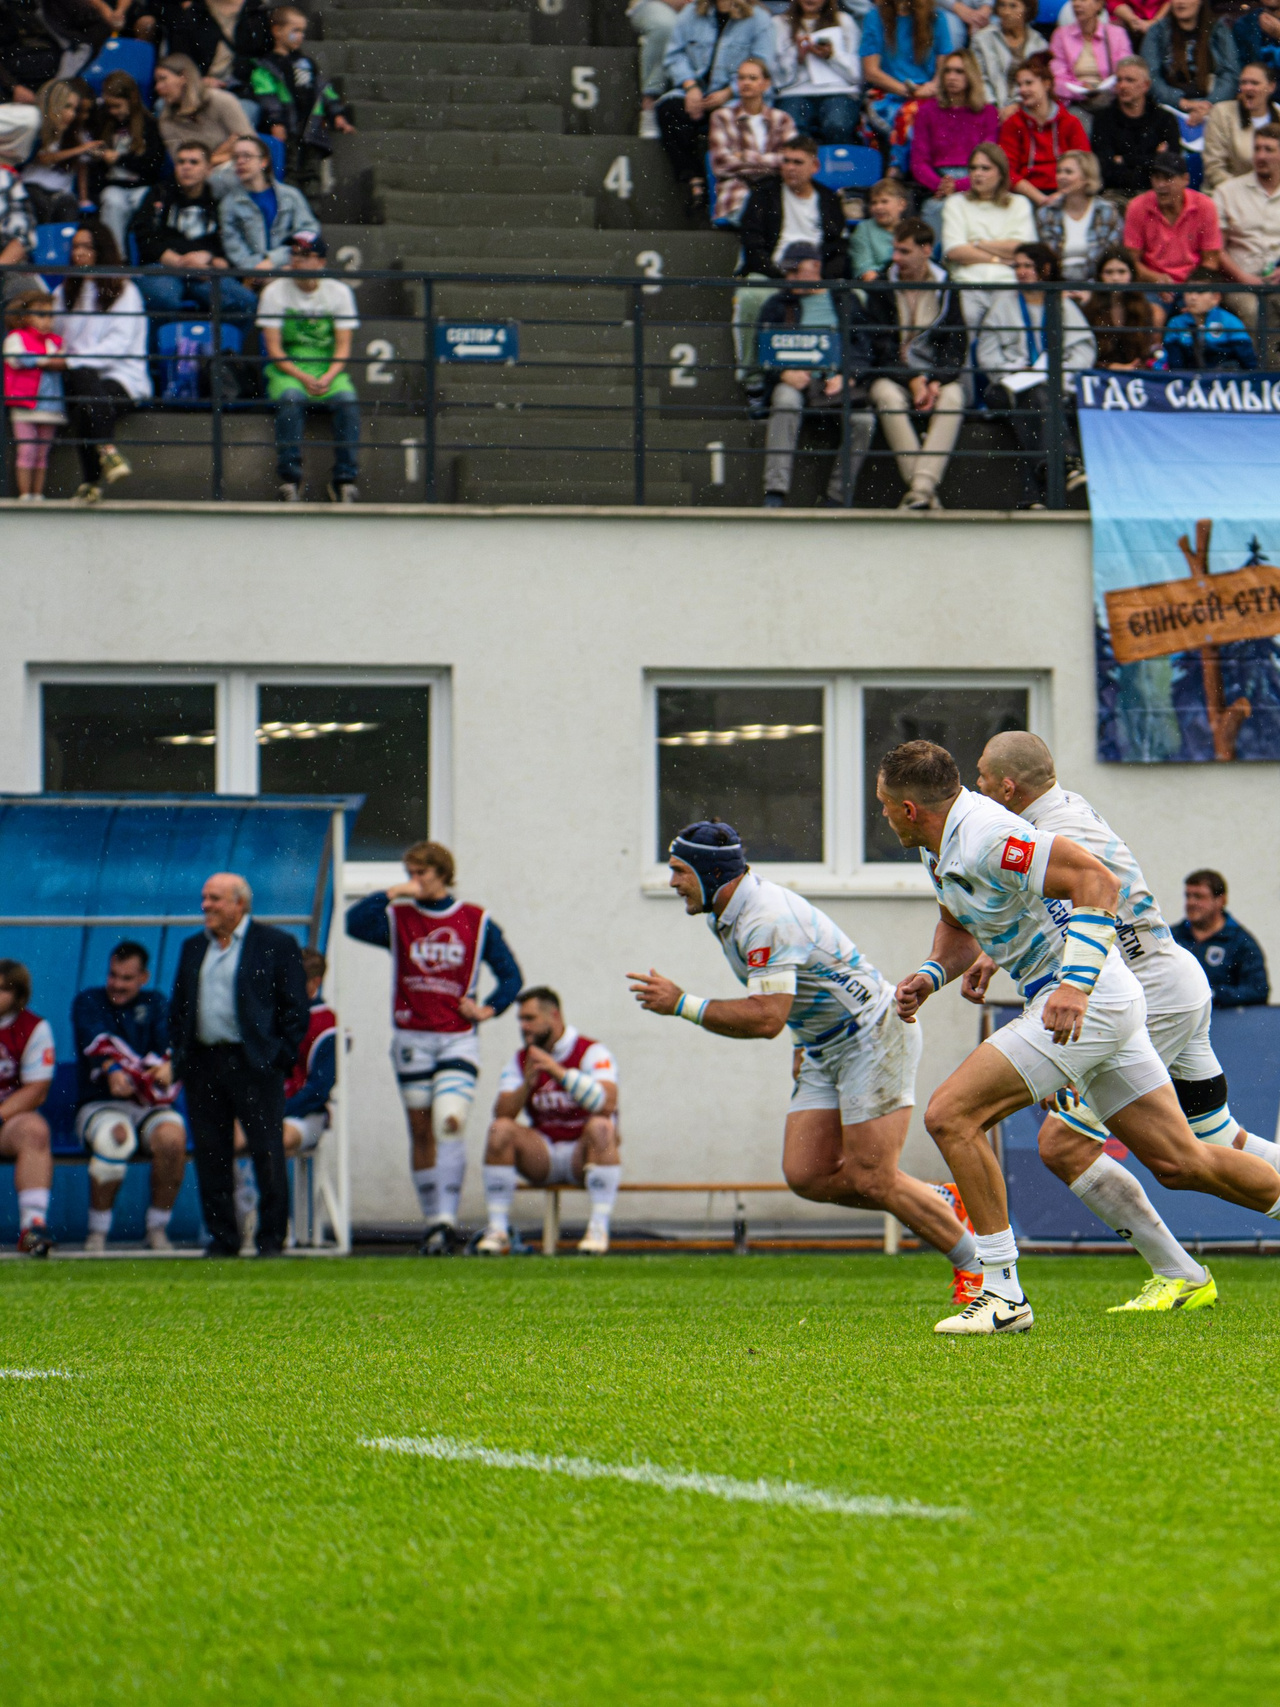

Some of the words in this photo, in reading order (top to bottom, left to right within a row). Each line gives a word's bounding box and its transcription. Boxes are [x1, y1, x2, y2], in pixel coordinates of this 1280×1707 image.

[571, 66, 598, 110] 5
[603, 155, 633, 199] 4
[636, 250, 663, 294] 3
[495, 327, 507, 343] 4
[819, 334, 830, 350] 5
[366, 338, 394, 384] 2
[669, 343, 698, 388] 2
[1080, 375, 1149, 411] ГДЕ
[400, 437, 419, 482] 1
[706, 441, 725, 485] 1
